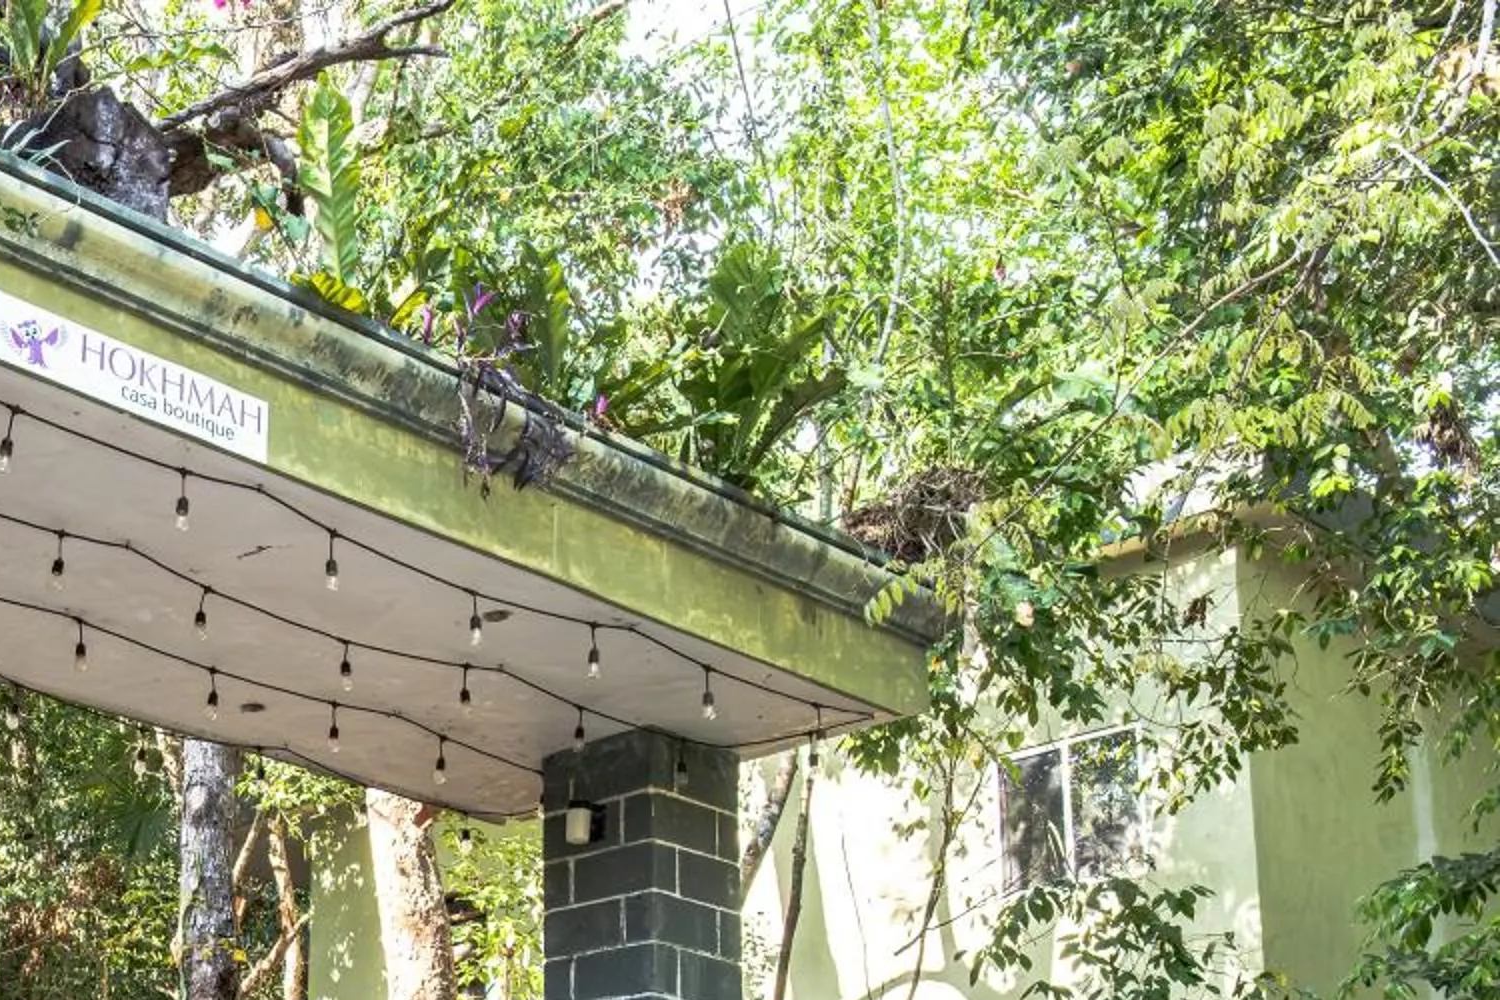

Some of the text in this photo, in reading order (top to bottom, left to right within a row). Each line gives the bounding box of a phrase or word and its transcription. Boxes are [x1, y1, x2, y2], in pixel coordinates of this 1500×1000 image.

[80, 333, 262, 434] HOKHMAH
[121, 384, 235, 441] casa boutique
